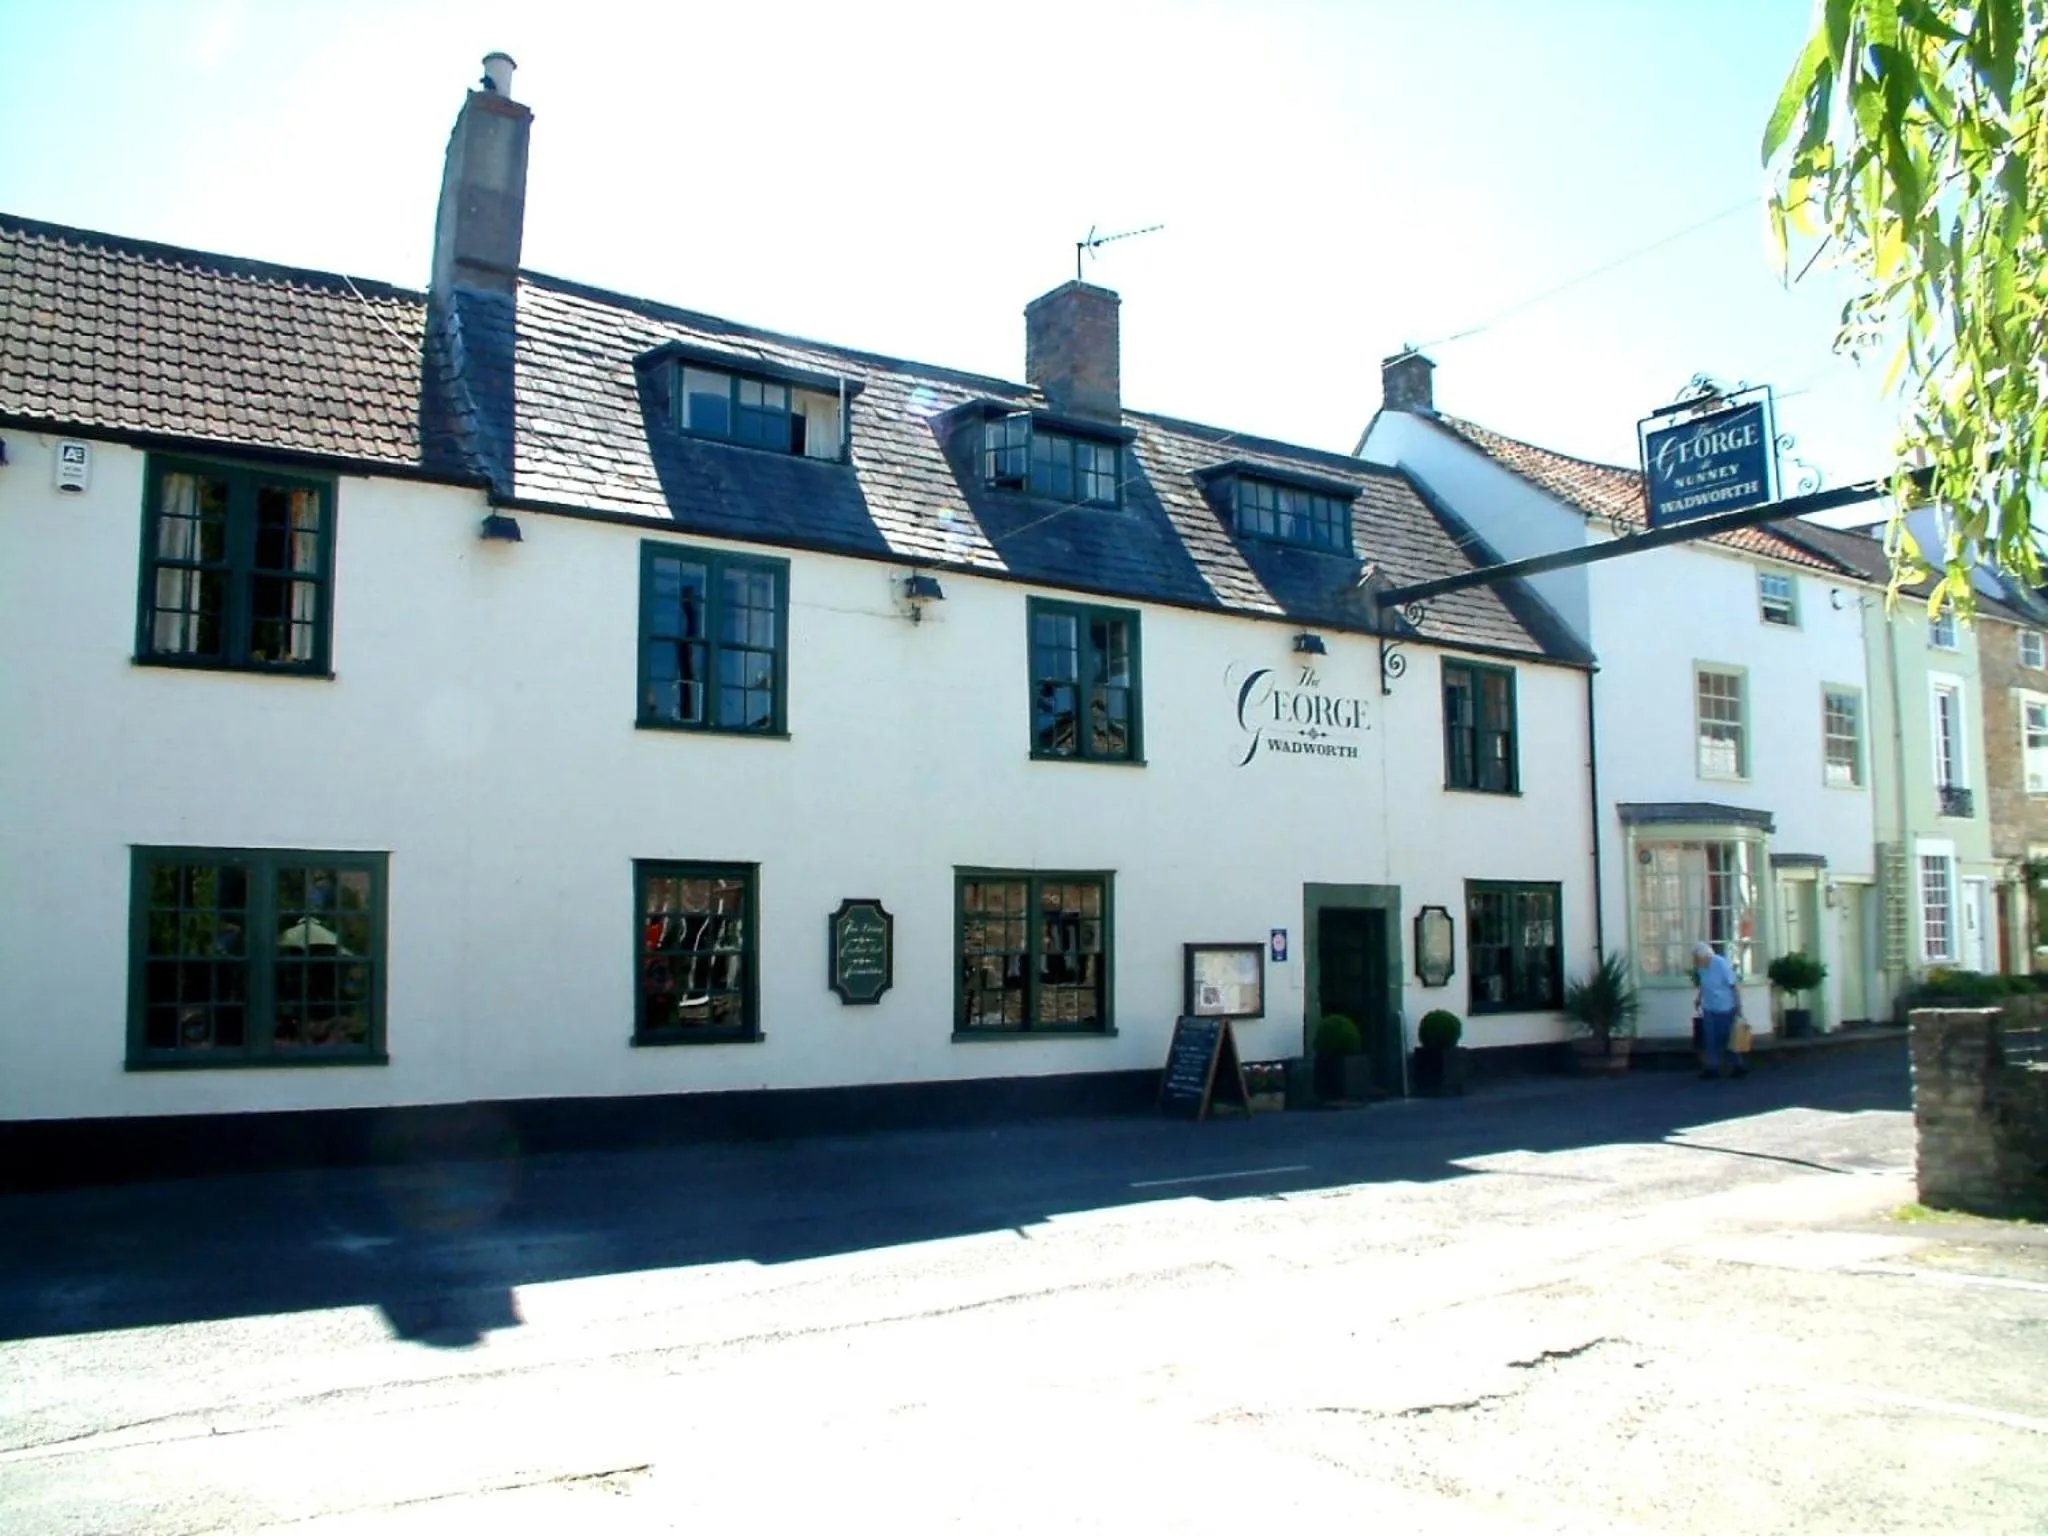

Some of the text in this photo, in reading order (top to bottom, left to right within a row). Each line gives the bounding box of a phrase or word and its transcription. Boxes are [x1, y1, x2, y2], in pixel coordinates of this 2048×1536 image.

[1655, 423, 1758, 481] GEORGE
[1674, 464, 1739, 486] NUNNEY
[1660, 481, 1758, 513] WADWORTH
[1298, 664, 1321, 687] The
[1229, 664, 1372, 768] GEORGE
[1267, 738, 1359, 759] WADWORTH
